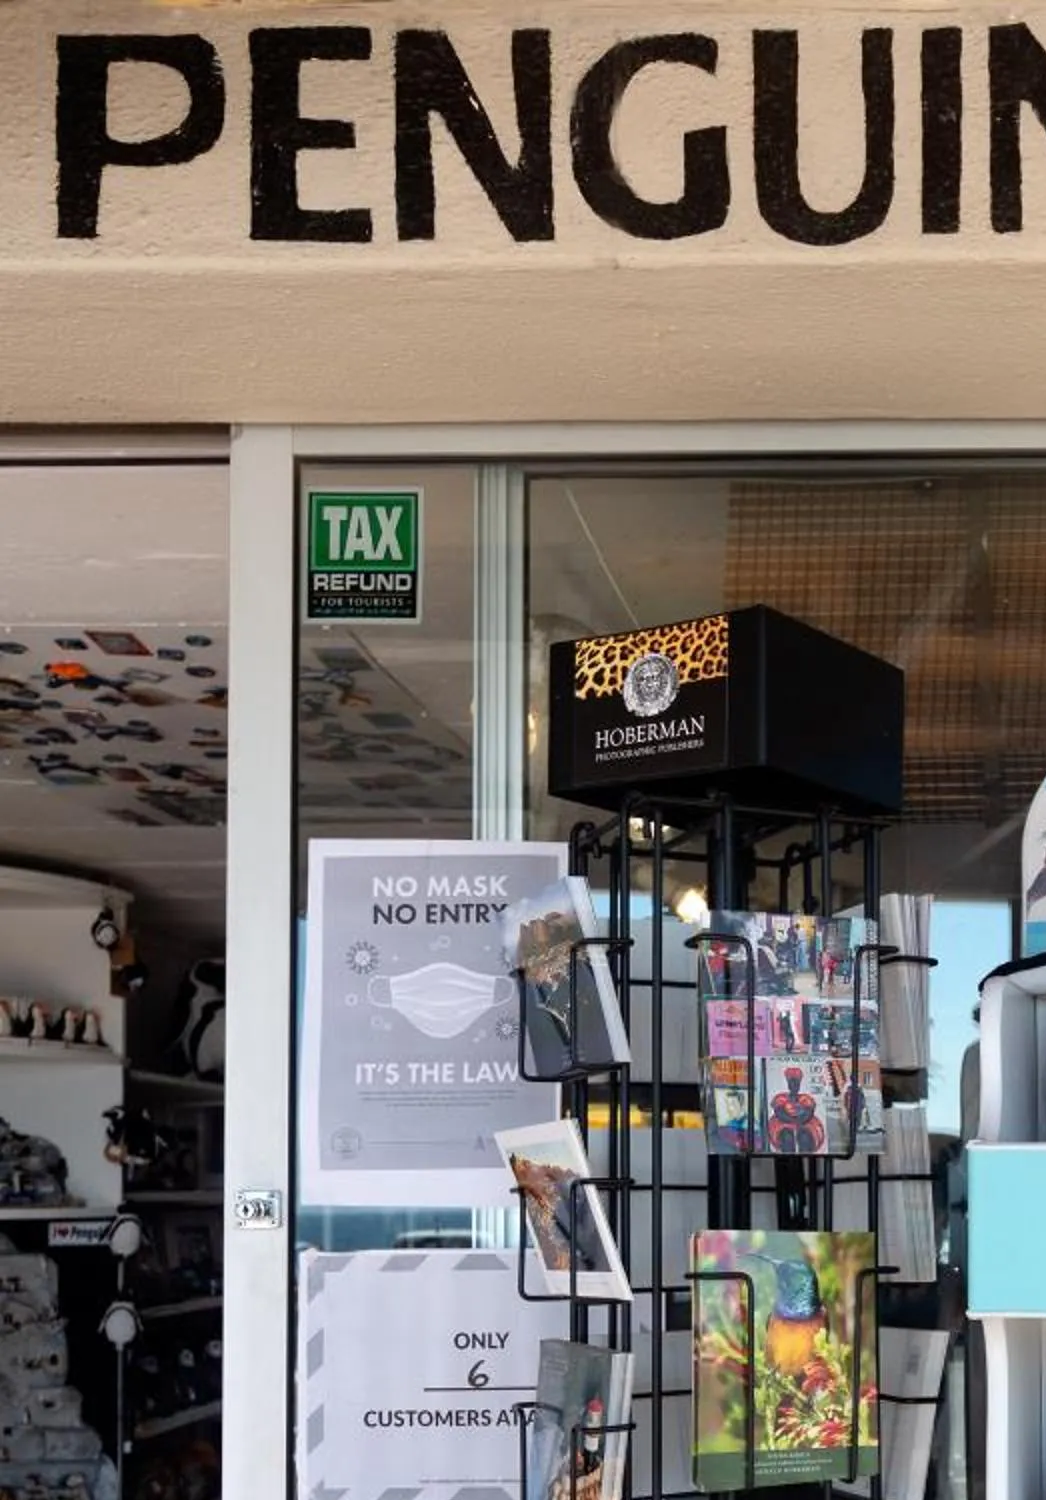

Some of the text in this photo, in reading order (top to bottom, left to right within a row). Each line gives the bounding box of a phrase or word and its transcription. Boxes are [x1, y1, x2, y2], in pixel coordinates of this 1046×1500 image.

[322, 505, 404, 562] TAX
[313, 573, 413, 592] REFUND
[594, 714, 705, 750] HOBERMAN
[373, 874, 509, 897] NO MASK
[373, 903, 417, 925] NO
[355, 1061, 519, 1085] IT'S THE LAW
[453, 1332, 509, 1350] ONLY
[467, 1359, 489, 1388] 6
[363, 1409, 492, 1428] CUSTOMERS
